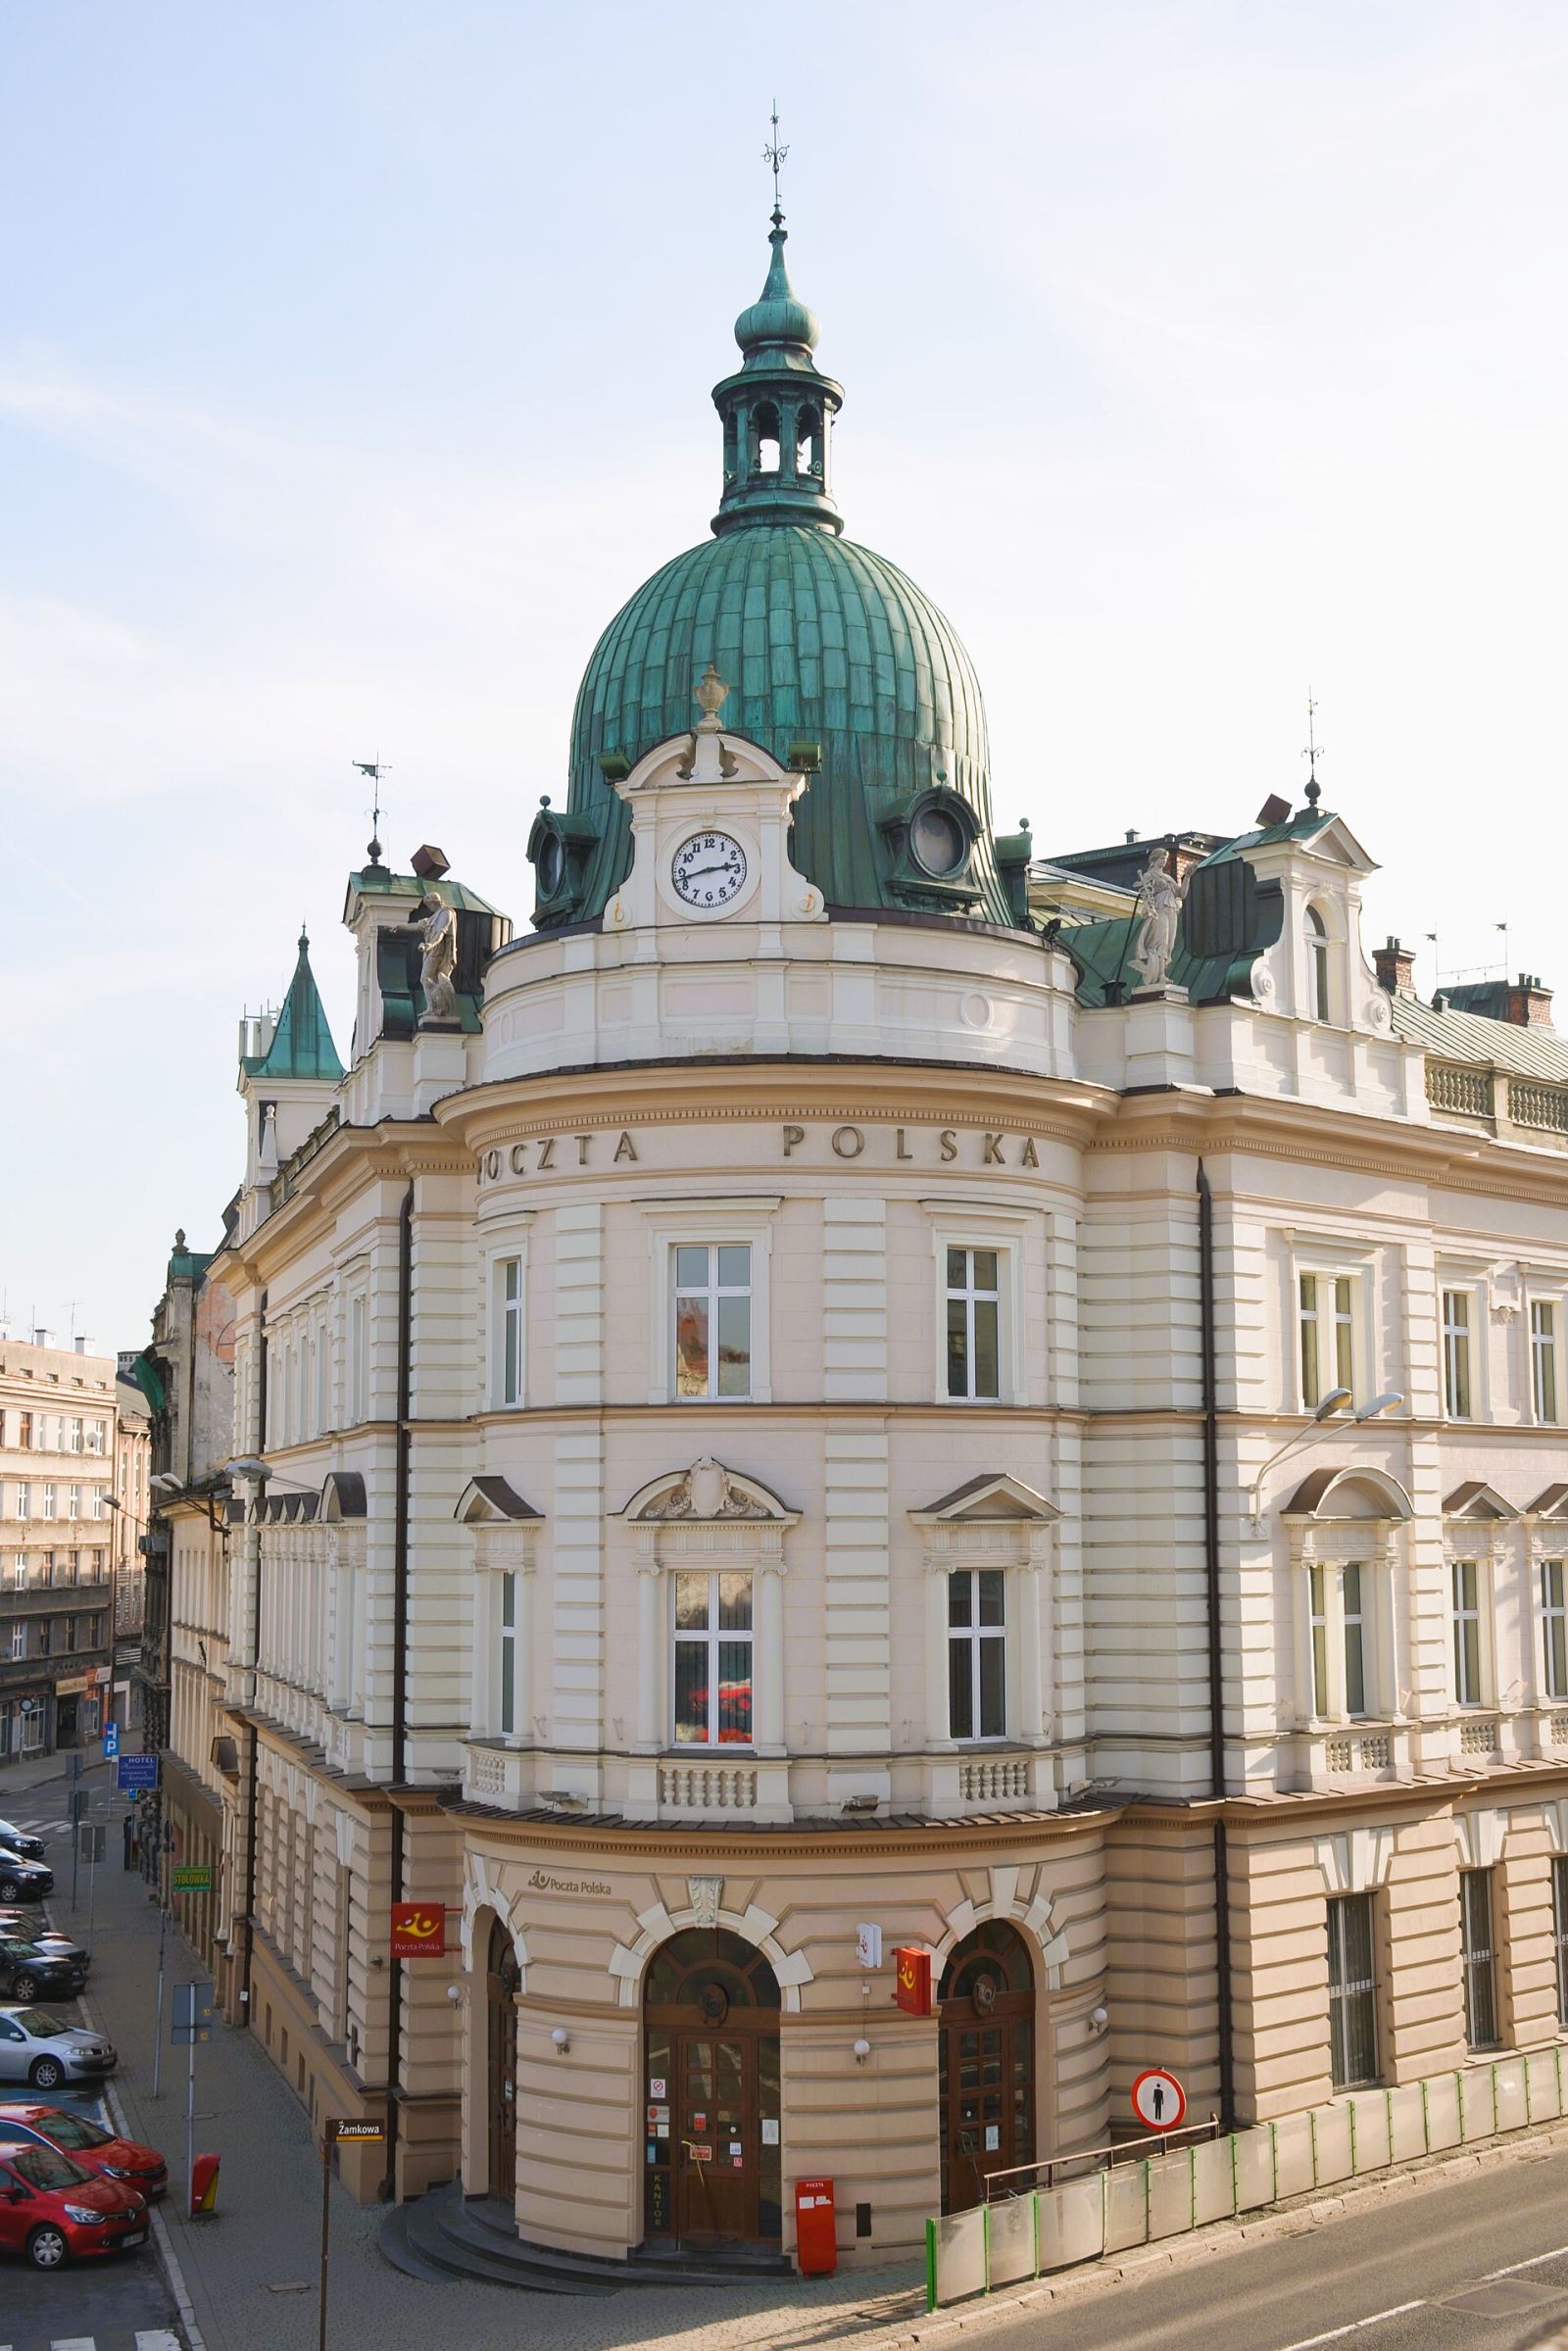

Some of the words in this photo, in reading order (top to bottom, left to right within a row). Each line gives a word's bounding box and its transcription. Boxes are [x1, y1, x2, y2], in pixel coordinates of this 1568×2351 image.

[692, 843, 701, 853] 11
[704, 838, 715, 849] 12
[720, 842, 725, 852] 1
[682, 853, 694, 863] 10
[730, 851, 737, 860] 2
[733, 863, 741, 874] 3
[728, 876, 737, 888] 4
[692, 889, 700, 900] 7
[705, 891, 713, 902] 6
[718, 887, 726, 898] 5
[783, 1126, 1040, 1168] POLSKA
[107, 1740, 117, 1753] P
[551, 1879, 579, 1892] Poczta
[580, 1882, 612, 1895] Polska
[338, 2125, 380, 2134] Zamkowa
[654, 2175, 662, 2227] KANTOR
